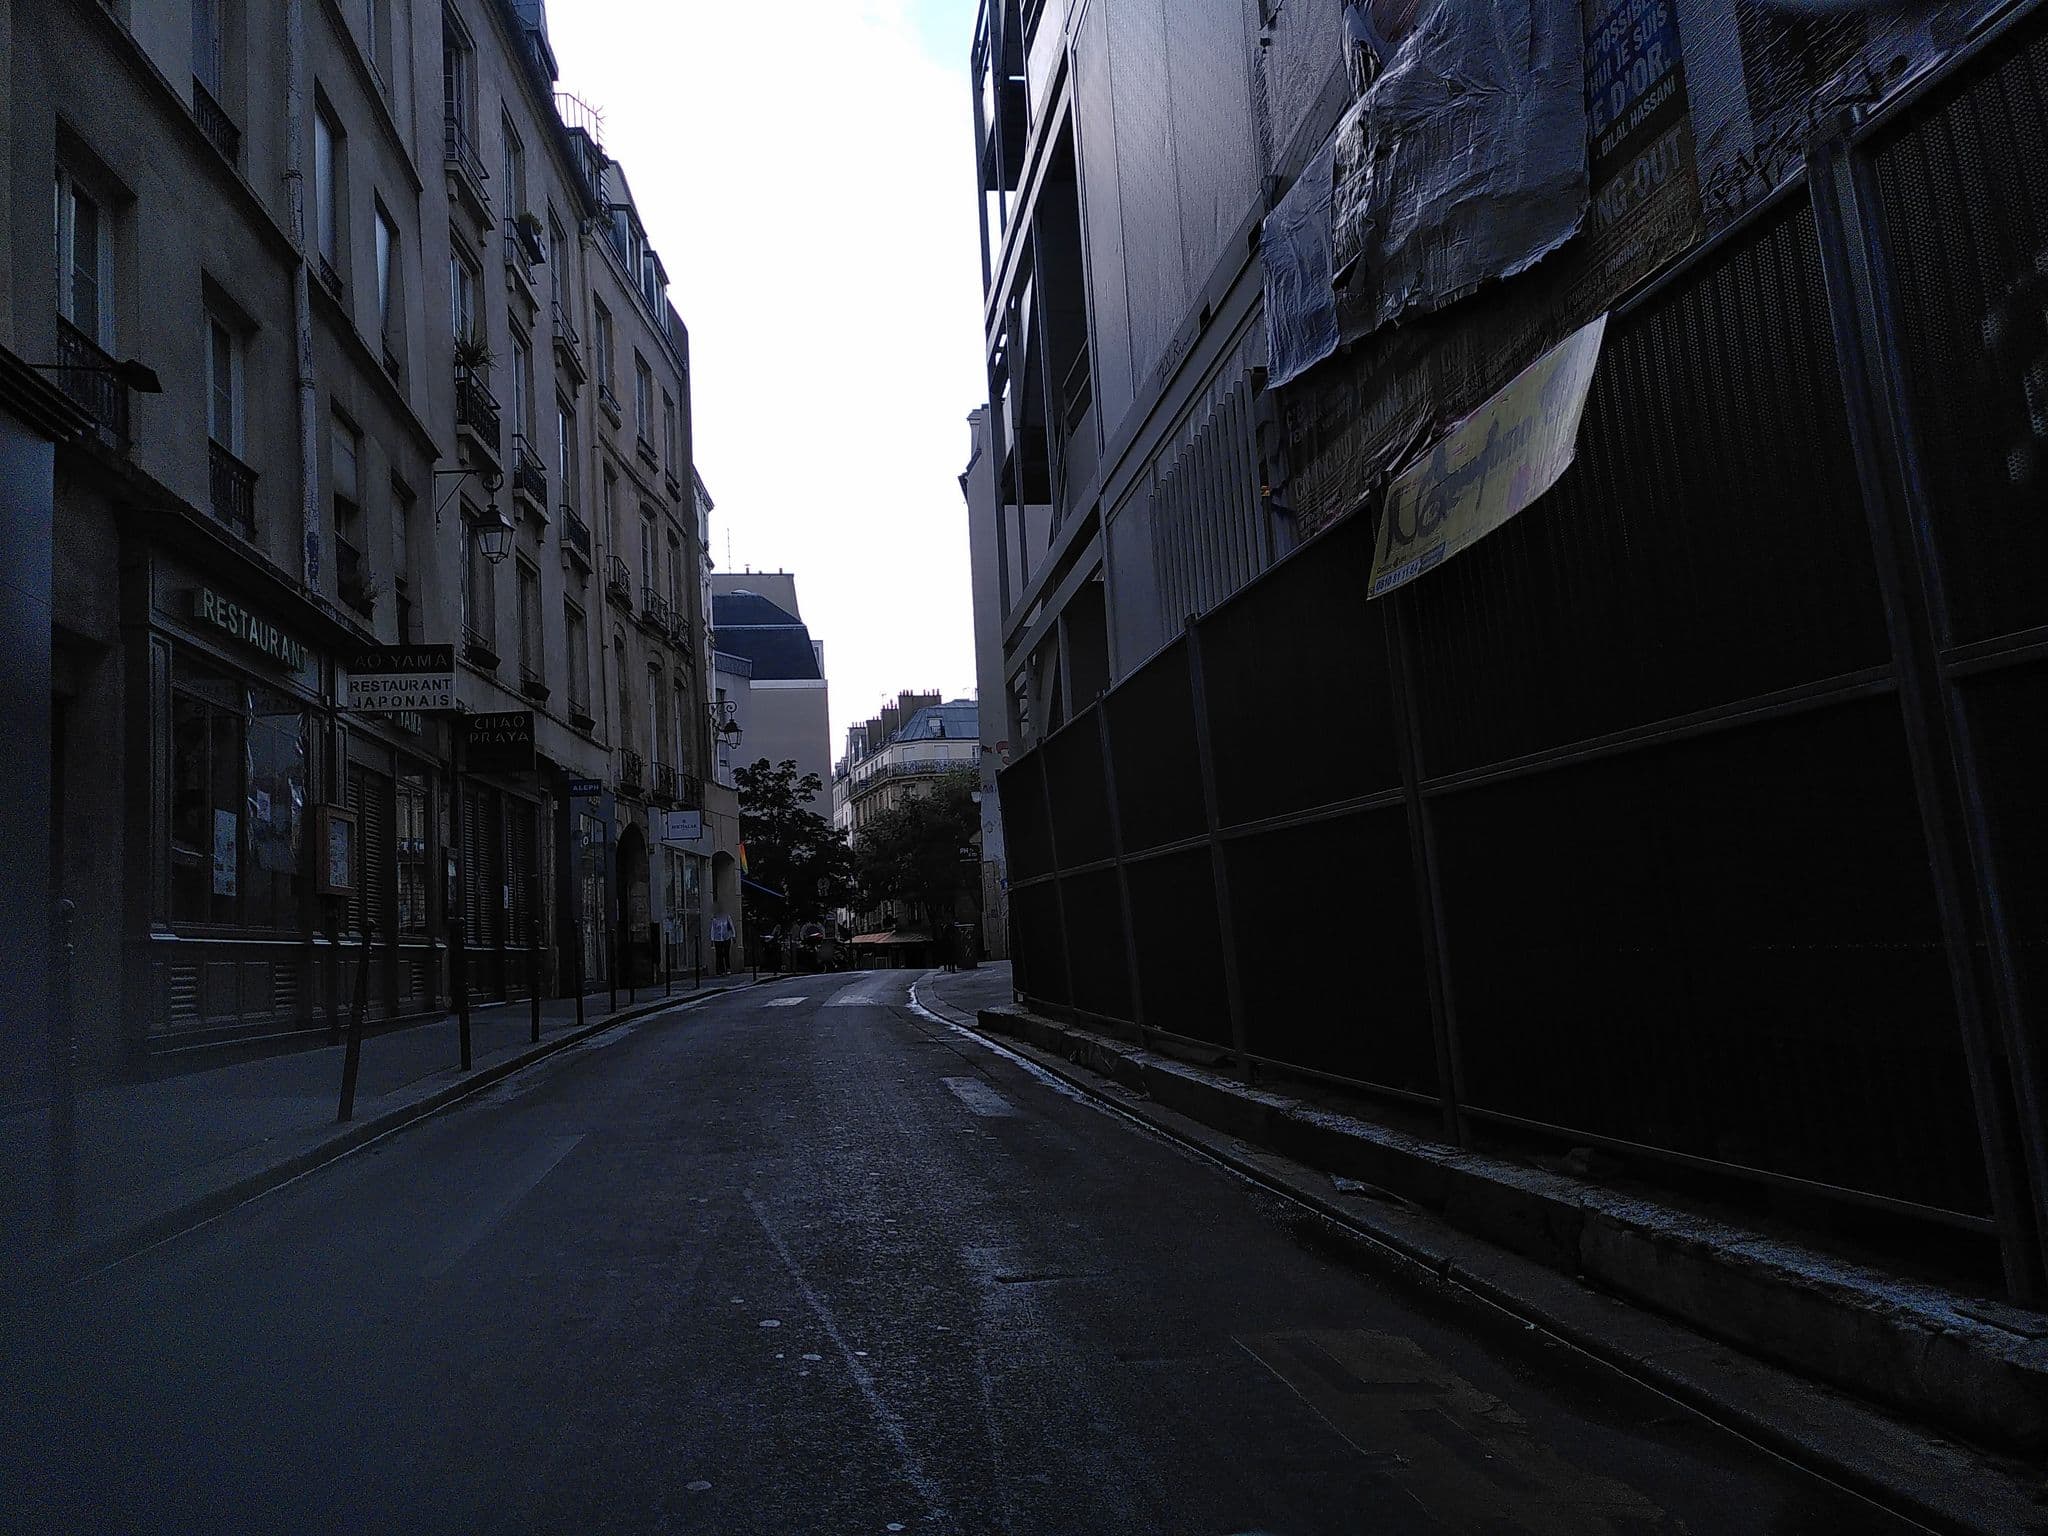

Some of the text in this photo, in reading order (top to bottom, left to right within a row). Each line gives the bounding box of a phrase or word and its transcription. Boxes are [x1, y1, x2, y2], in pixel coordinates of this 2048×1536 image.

[1633, 2, 1668, 51] SUIS
[1601, 121, 1630, 157] BILAL
[1630, 74, 1677, 130] HASSANI
[203, 587, 309, 673] RESTAURANT
[354, 655, 448, 669] AO YAMA
[349, 679, 453, 694] RESTAURANT
[353, 694, 450, 709] JAPONAIS
[470, 731, 529, 744] PRAYA
[572, 783, 600, 792] ALEPH
